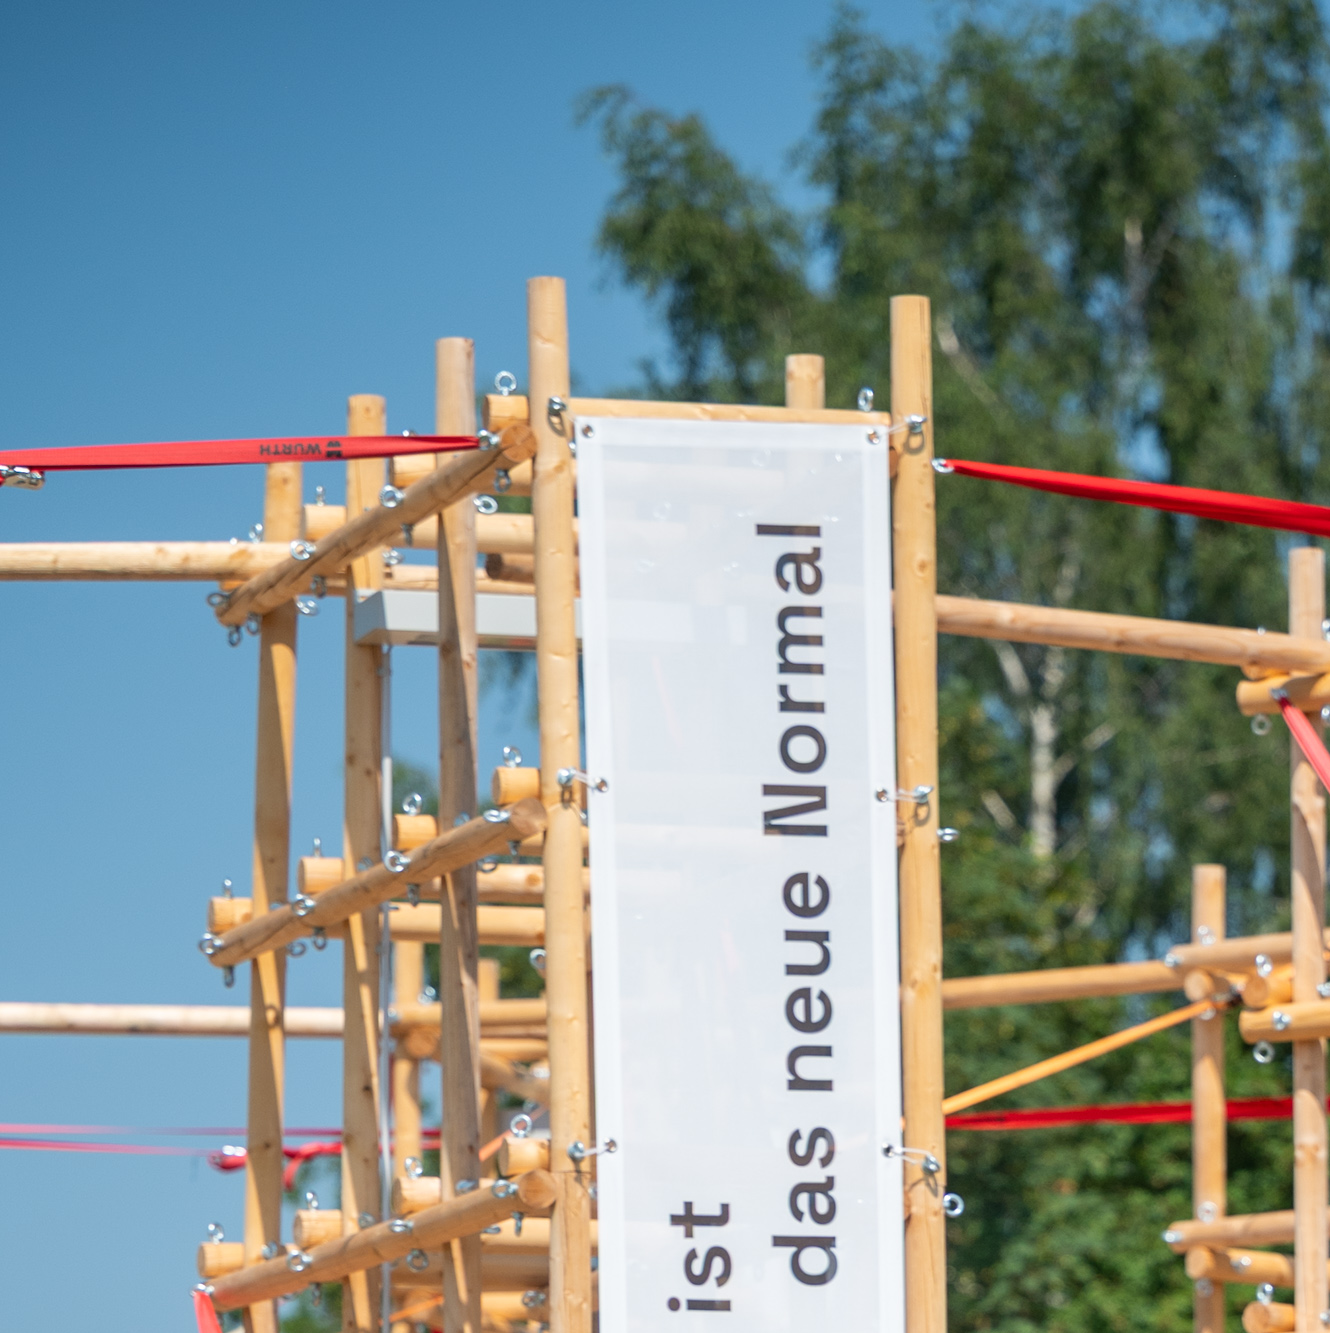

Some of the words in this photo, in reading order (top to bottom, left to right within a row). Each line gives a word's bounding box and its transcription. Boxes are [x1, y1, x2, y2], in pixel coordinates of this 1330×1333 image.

[754, 522, 829, 838] Normal
[781, 871, 834, 1093] neue
[666, 1200, 733, 1313] ist
[771, 1126, 839, 1287] das
